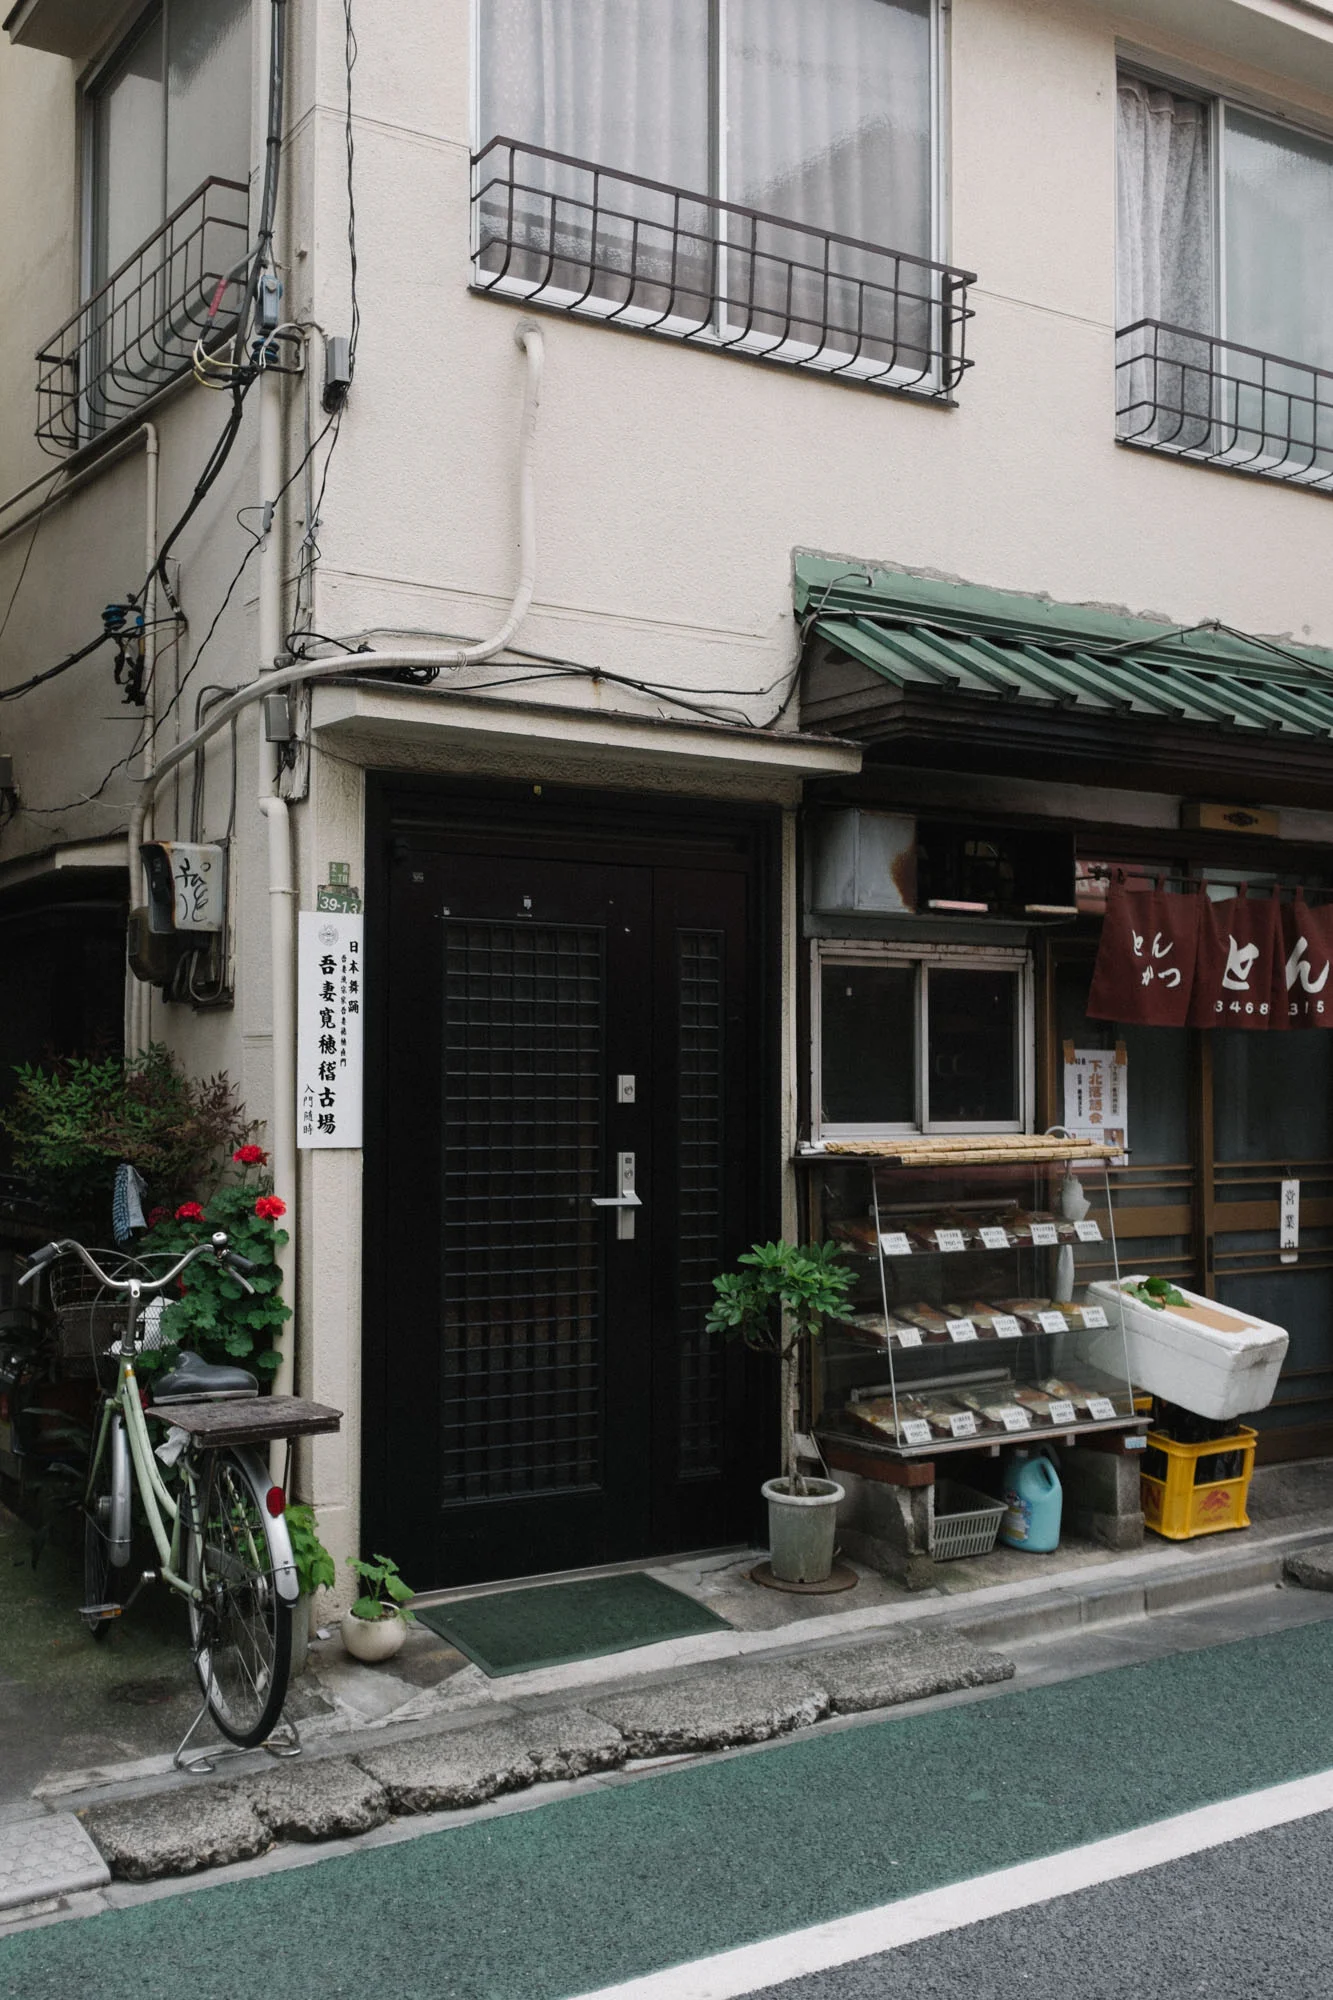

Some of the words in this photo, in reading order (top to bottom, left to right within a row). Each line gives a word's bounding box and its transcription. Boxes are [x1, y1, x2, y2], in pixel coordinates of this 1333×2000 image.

[319, 896, 358, 914] 39-13
[1131, 929, 1174, 959] とん
[348, 941, 359, 1014] 日本舞踊
[1141, 965, 1182, 988] かつ
[1215, 999, 1269, 1016] 3468
[303, 1083, 315, 1136] 入門随時
